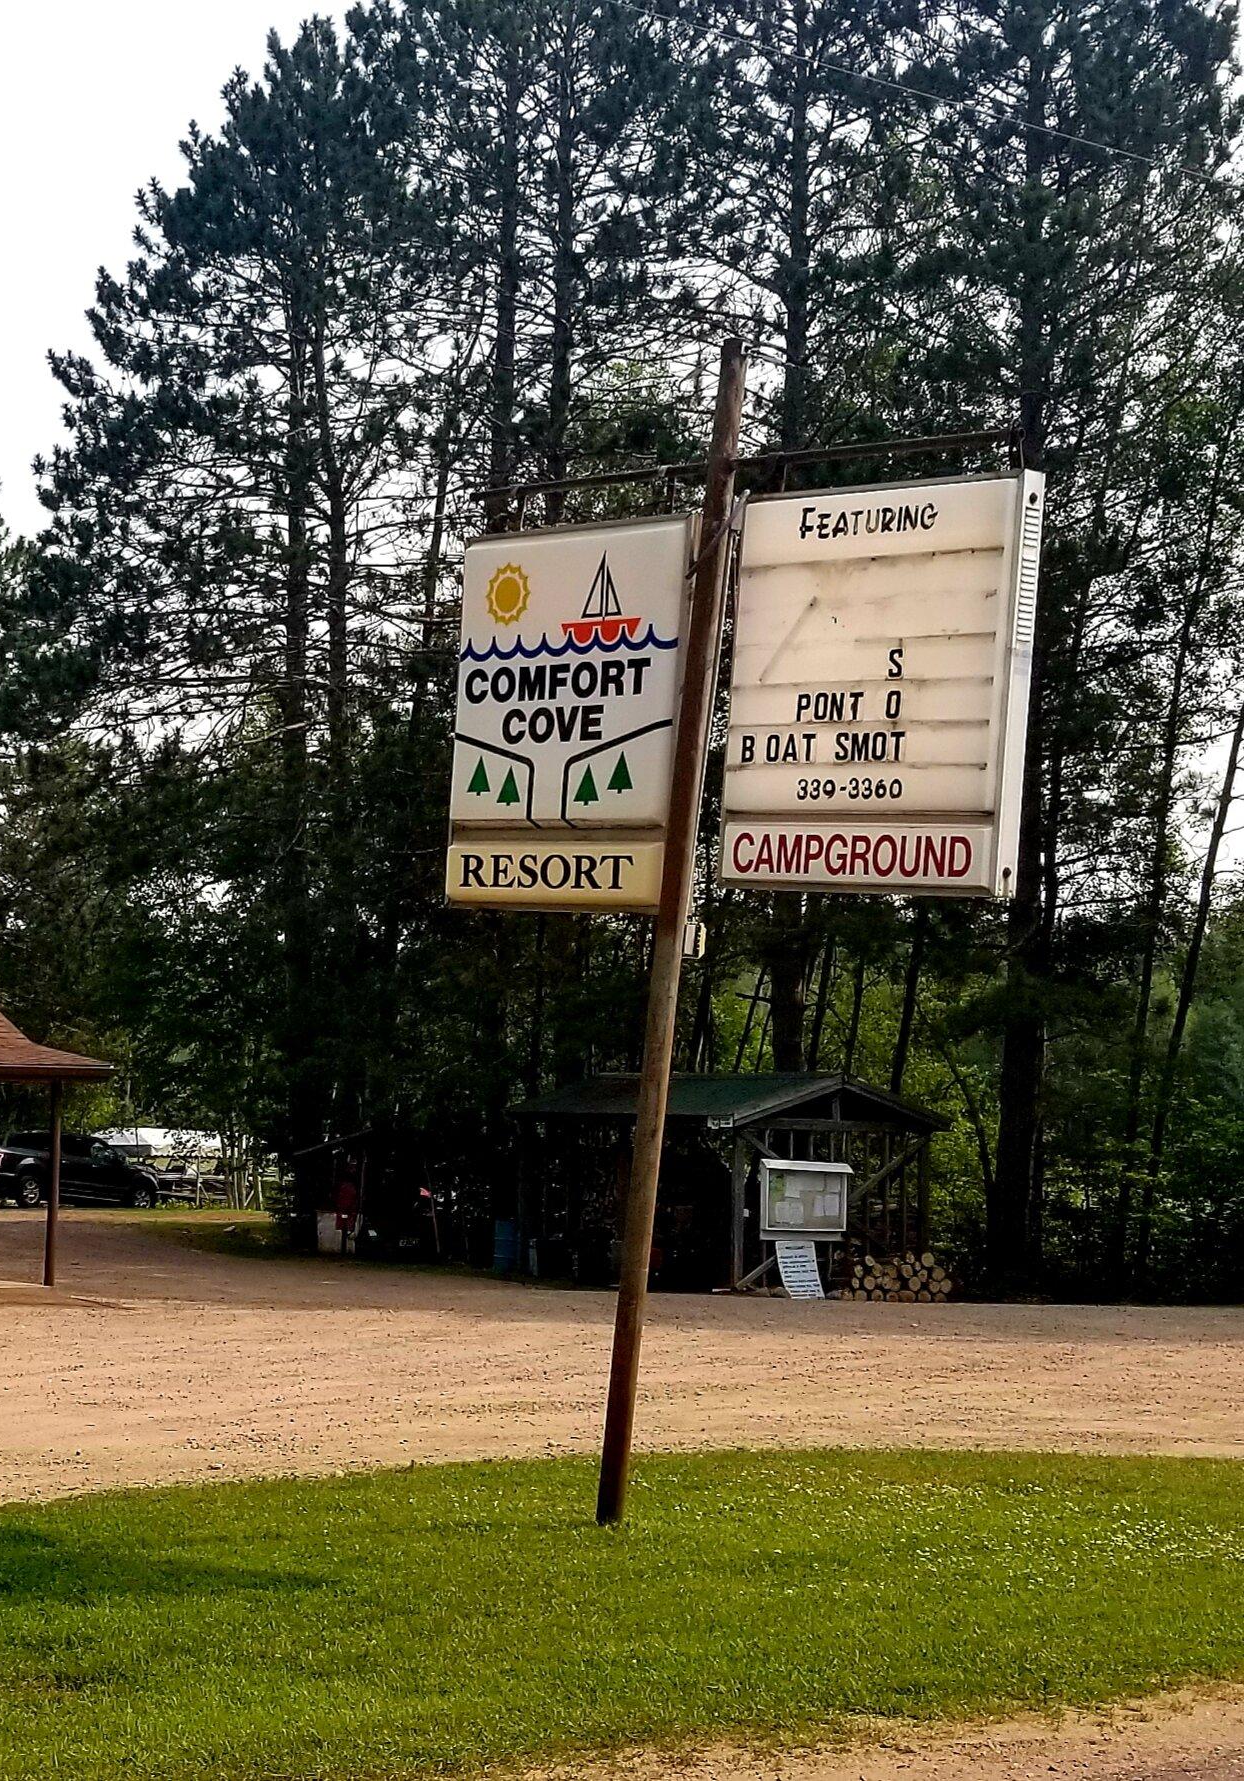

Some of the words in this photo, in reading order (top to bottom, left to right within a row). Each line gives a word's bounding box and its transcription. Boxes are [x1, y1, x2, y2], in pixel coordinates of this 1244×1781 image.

[464, 657, 651, 704] COMFORT
[887, 648, 904, 679] S
[501, 704, 605, 744] COVE
[834, 731, 906, 763] SMOT
[796, 777, 903, 801] 339-3360
[459, 854, 634, 890] RESORT
[732, 832, 973, 879] CAMPGROUND
